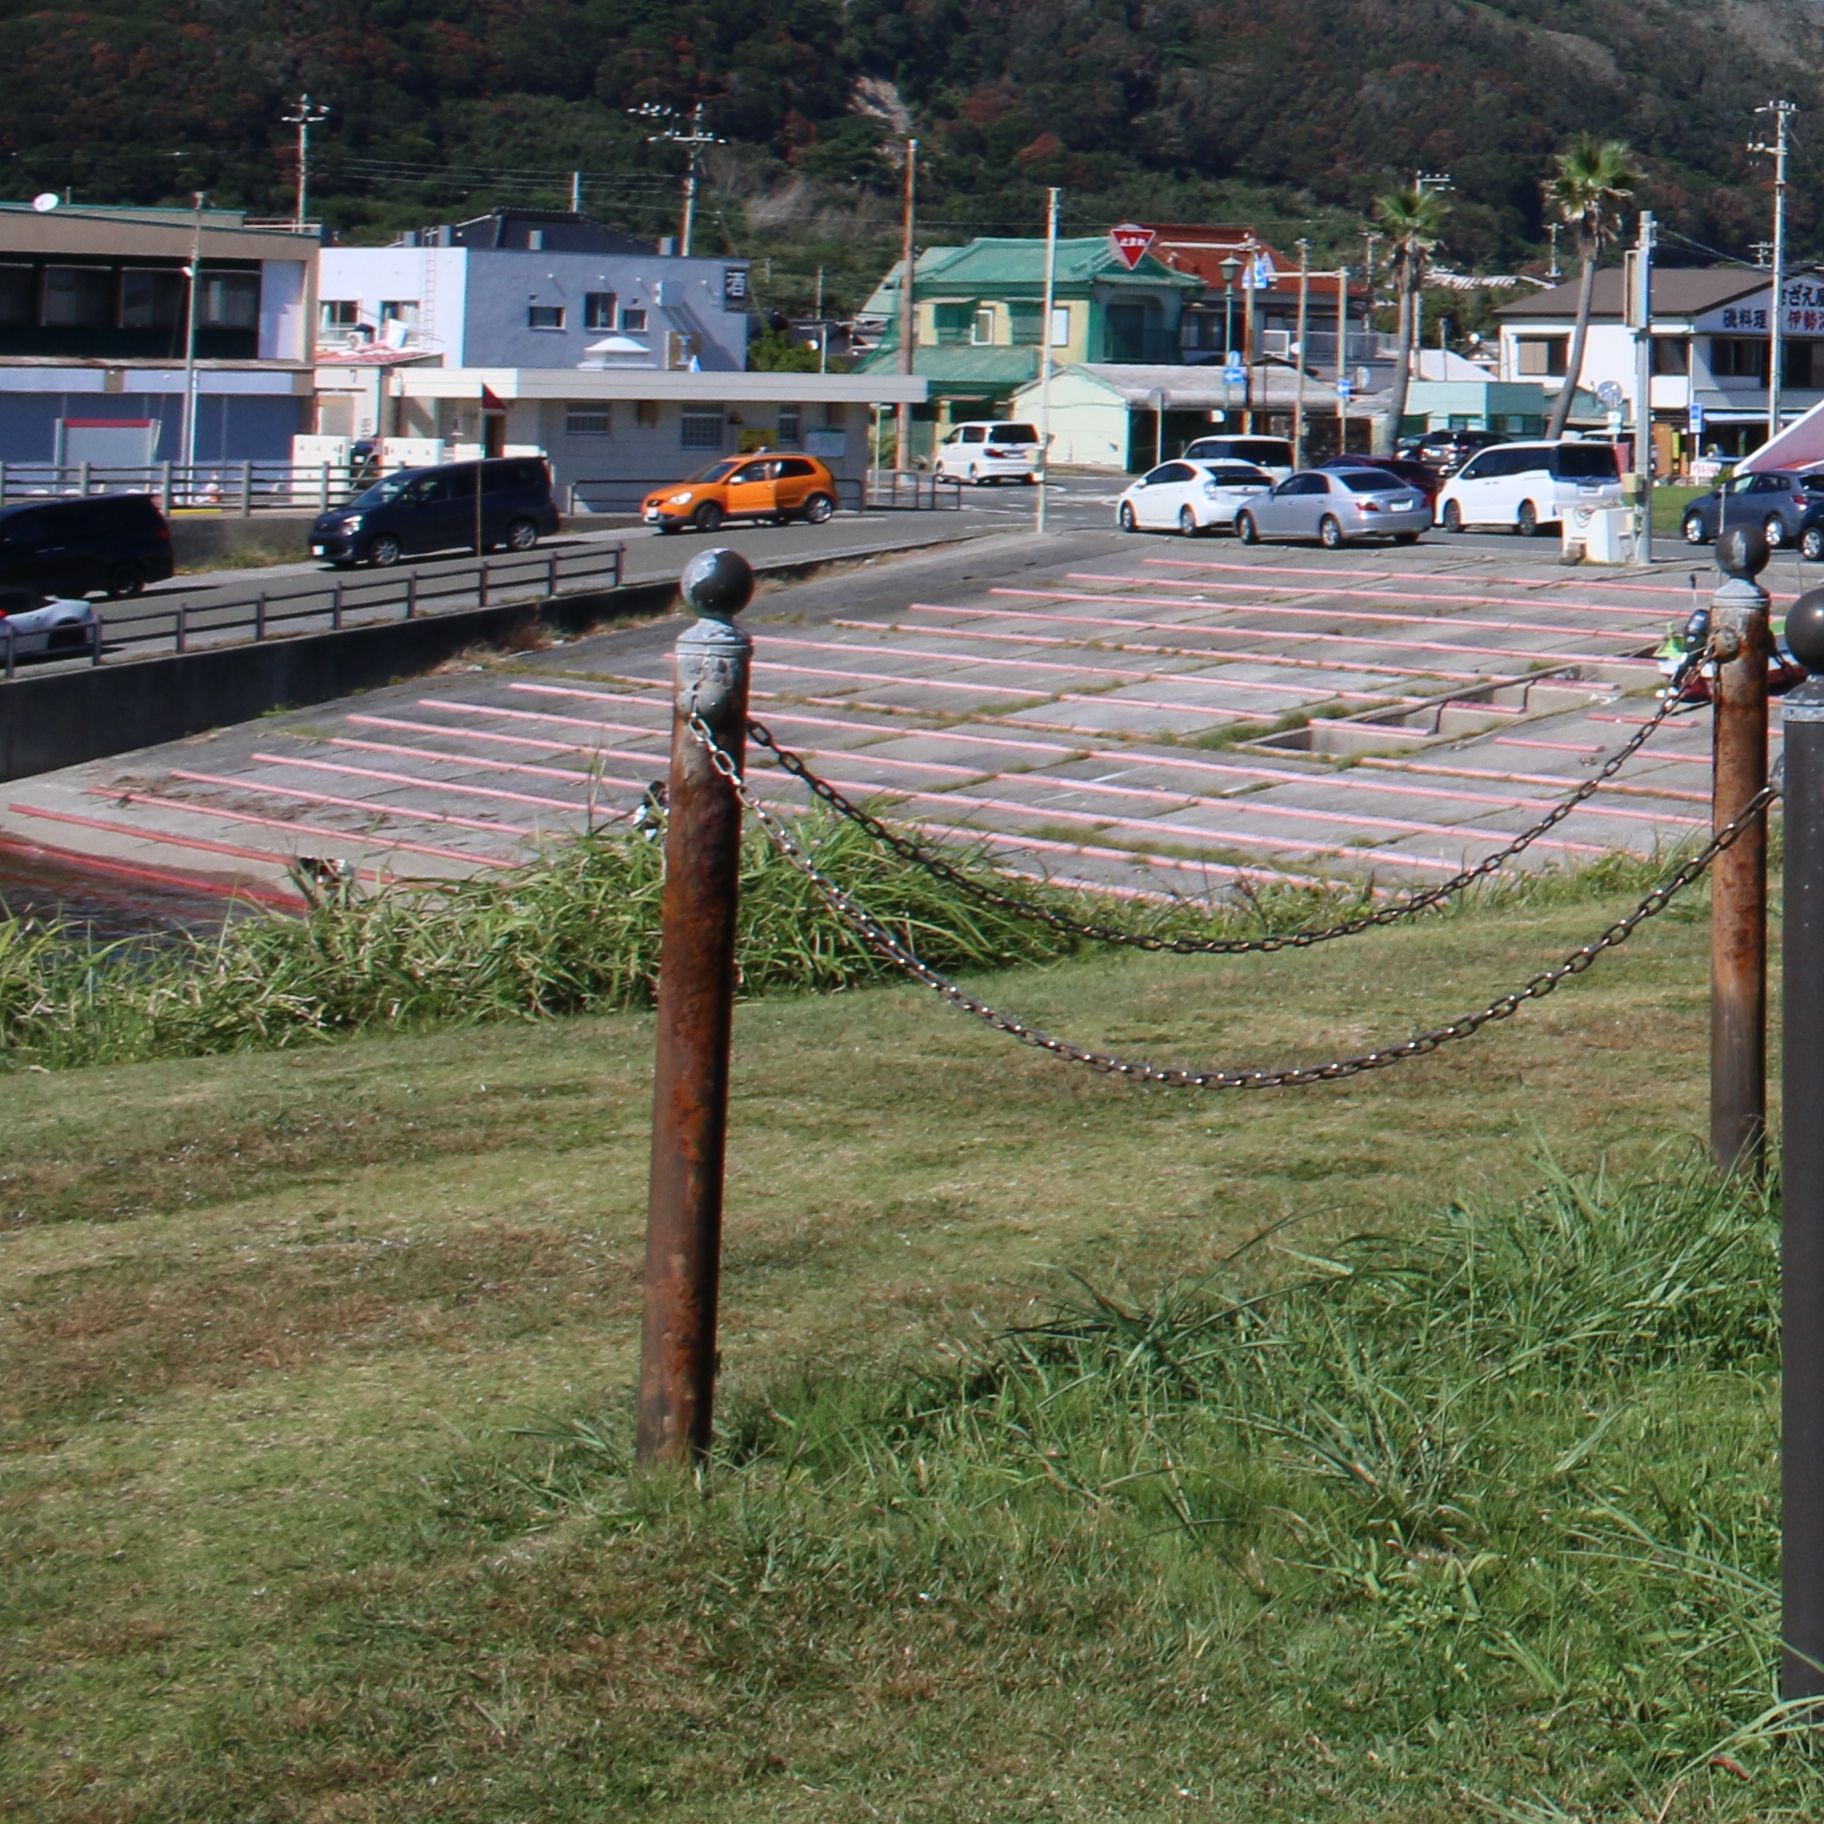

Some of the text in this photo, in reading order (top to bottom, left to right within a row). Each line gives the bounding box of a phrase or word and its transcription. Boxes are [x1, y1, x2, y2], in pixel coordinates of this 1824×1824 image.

[1119, 236, 1148, 247] 止まれ
[1722, 307, 1768, 329] 磯料理
